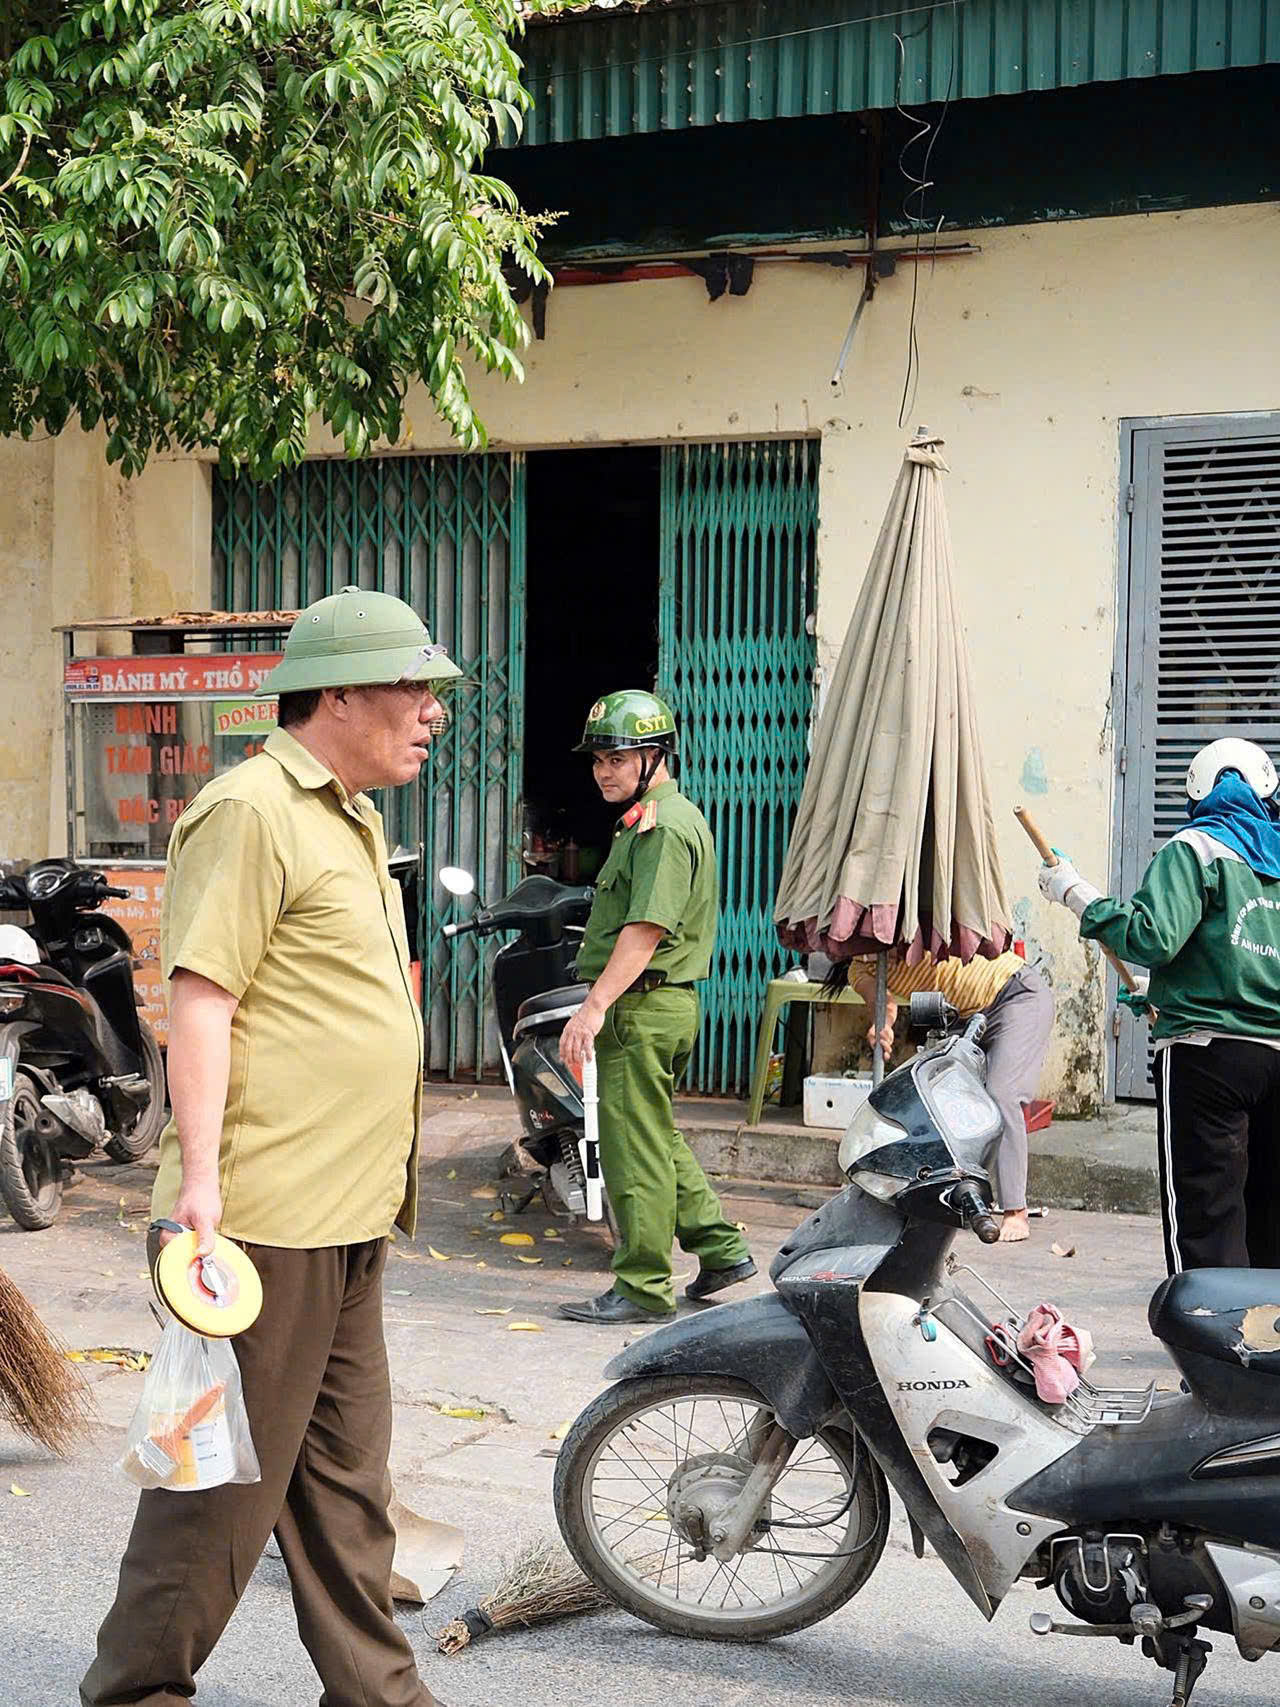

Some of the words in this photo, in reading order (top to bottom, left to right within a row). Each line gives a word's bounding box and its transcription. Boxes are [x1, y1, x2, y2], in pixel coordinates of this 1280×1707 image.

[101, 669, 155, 691] BÁNH
[203, 661, 244, 688] THỔ
[218, 703, 279, 732] DONER
[896, 1379, 972, 1391] HONDA
